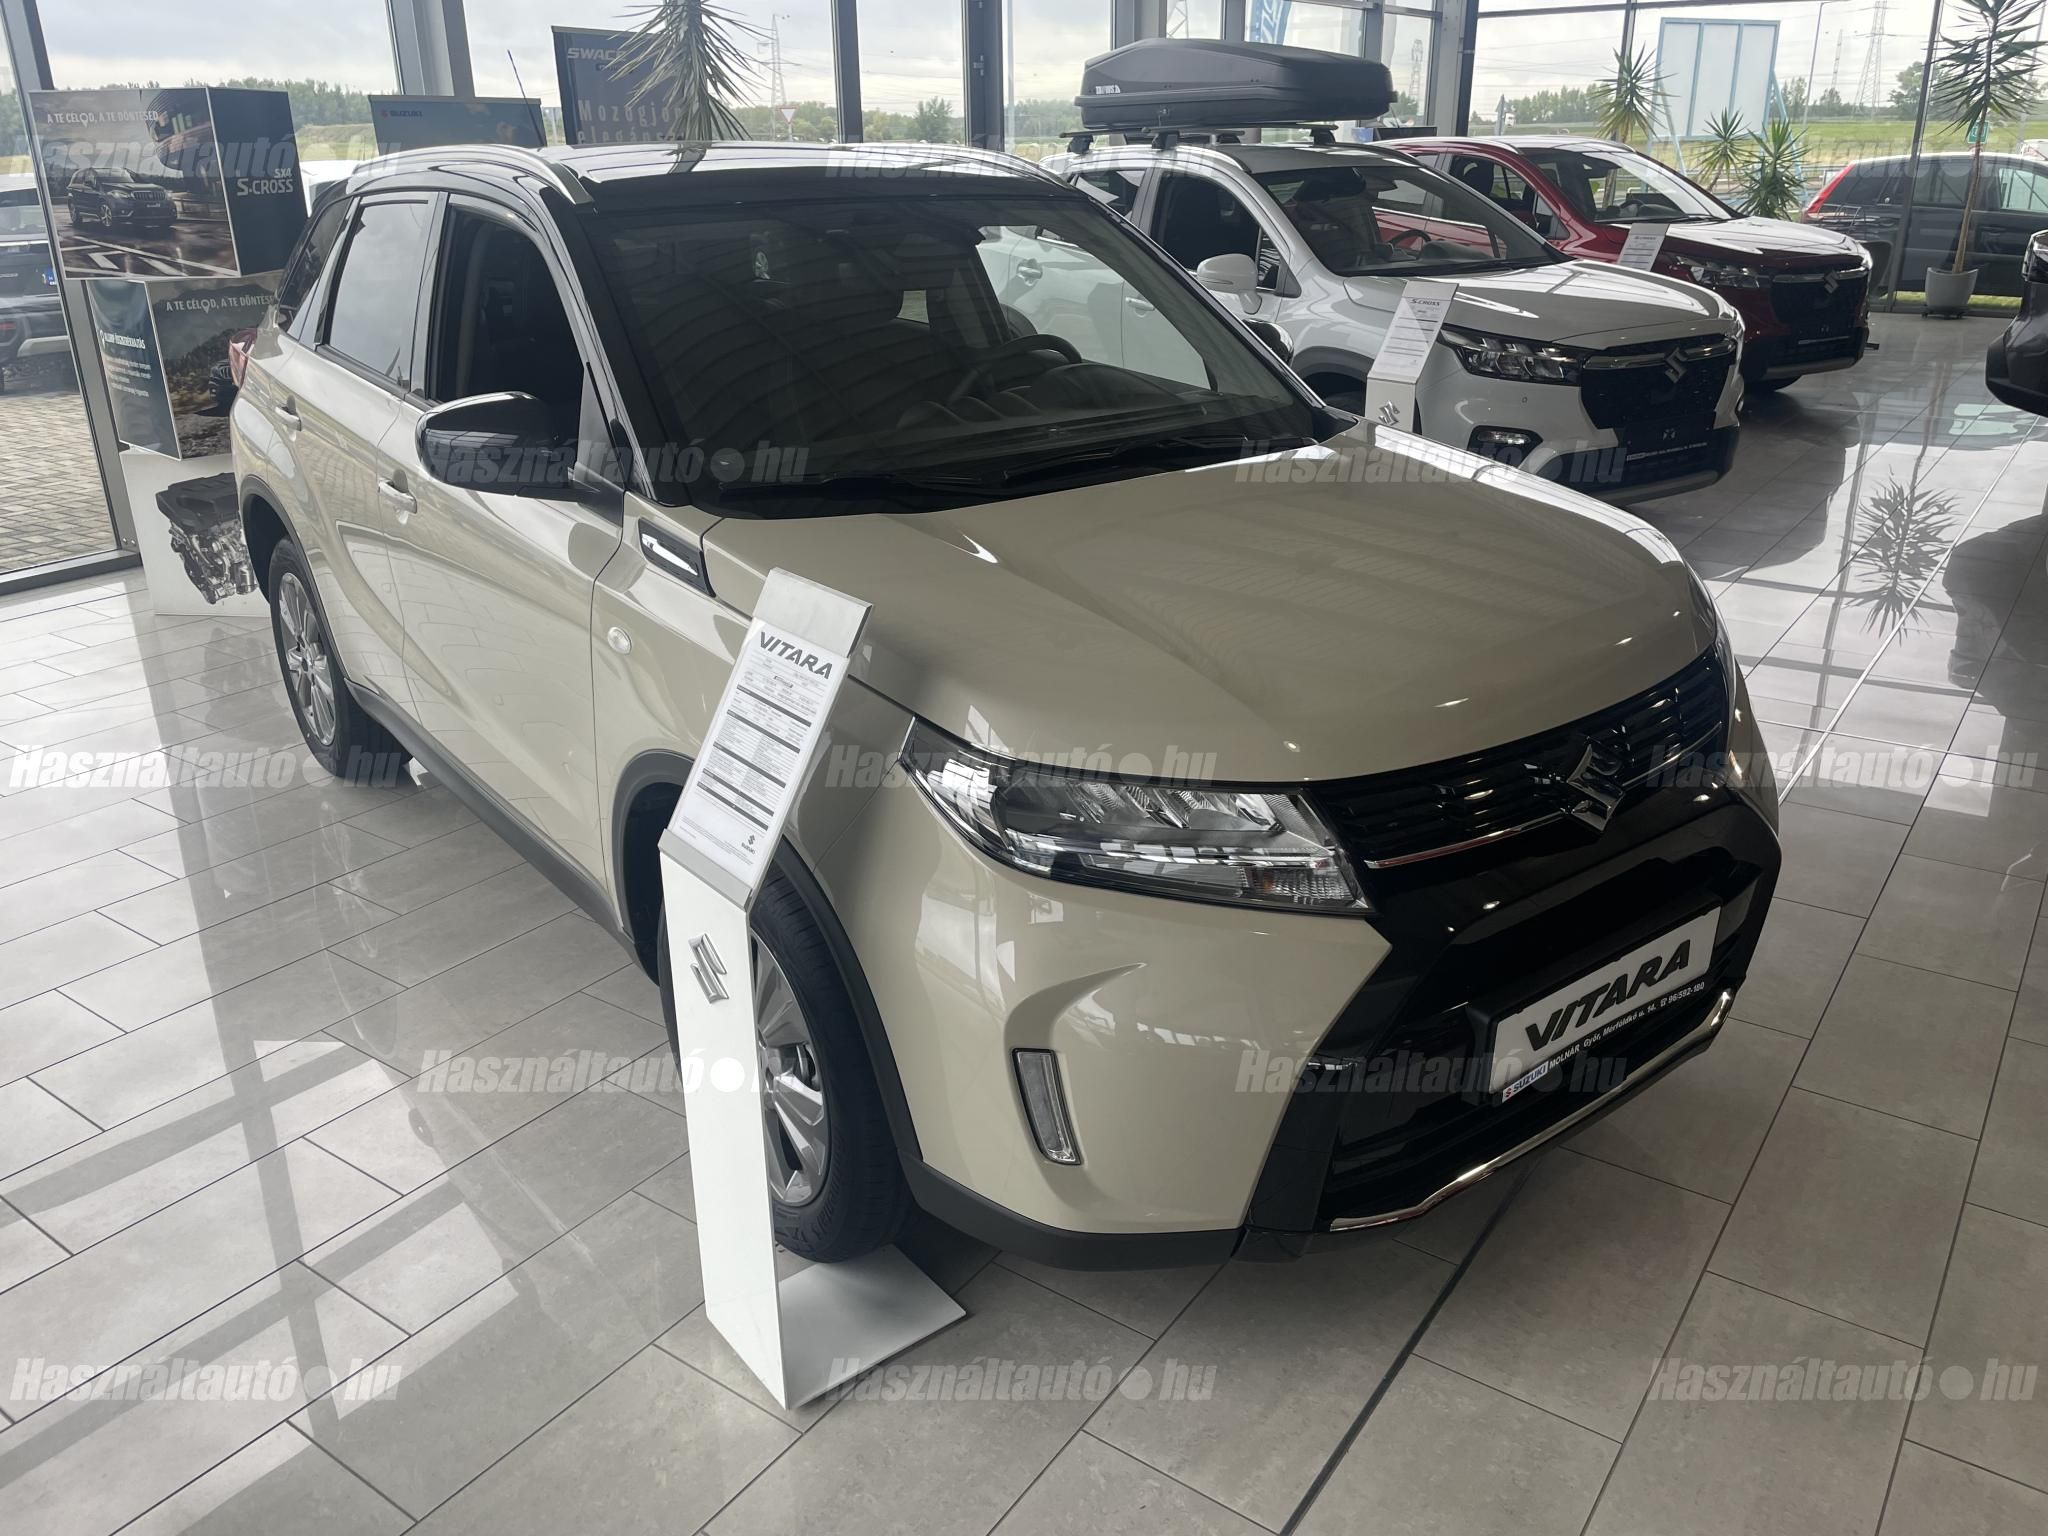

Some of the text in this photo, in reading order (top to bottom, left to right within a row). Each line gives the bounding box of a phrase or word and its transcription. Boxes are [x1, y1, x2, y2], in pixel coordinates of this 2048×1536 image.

[47, 114, 54, 124] A
[54, 113, 65, 124] TE
[99, 112, 106, 122] A
[106, 111, 117, 122] TE
[273, 168, 293, 179] SX4
[236, 177, 294, 197] S-CROSS
[166, 301, 174, 312] A
[175, 302, 185, 311] TE
[221, 298, 229, 308] A
[229, 297, 239, 307] TE
[760, 631, 832, 680] VITARA
[1525, 939, 1691, 1051] VITARA
[1513, 1066, 1547, 1092] SUZUKI
[1549, 1043, 1580, 1069] MOLNÁR
